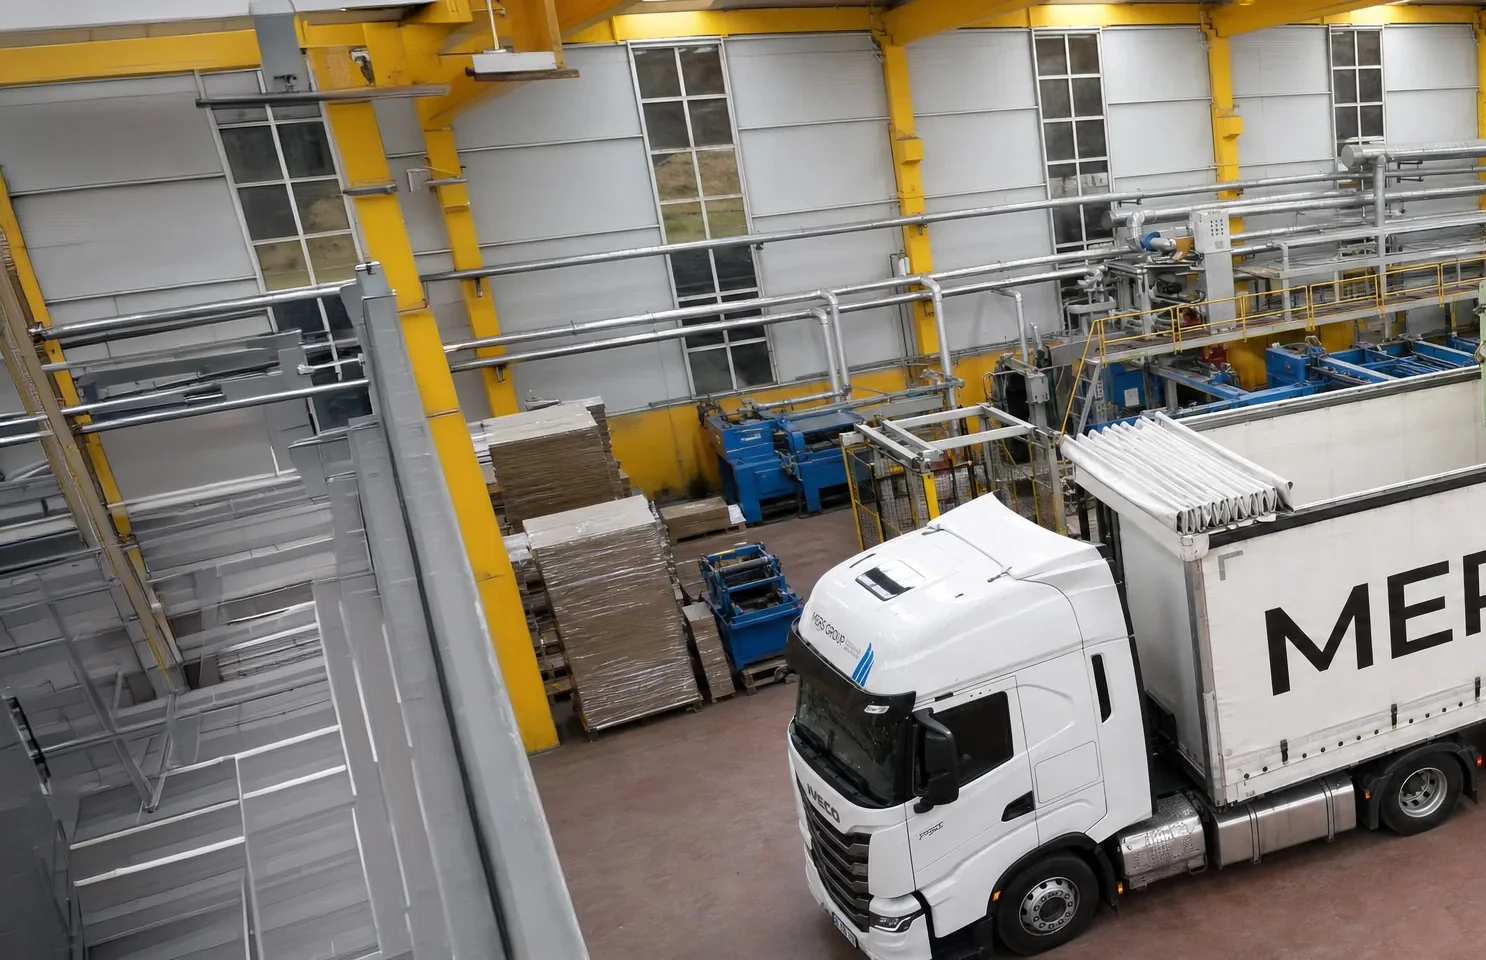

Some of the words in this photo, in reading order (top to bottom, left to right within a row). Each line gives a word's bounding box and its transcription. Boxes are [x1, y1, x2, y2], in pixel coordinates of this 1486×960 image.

[812, 611, 827, 631] MERS
[825, 624, 846, 646] GROUP
[806, 783, 841, 824] IVECO
